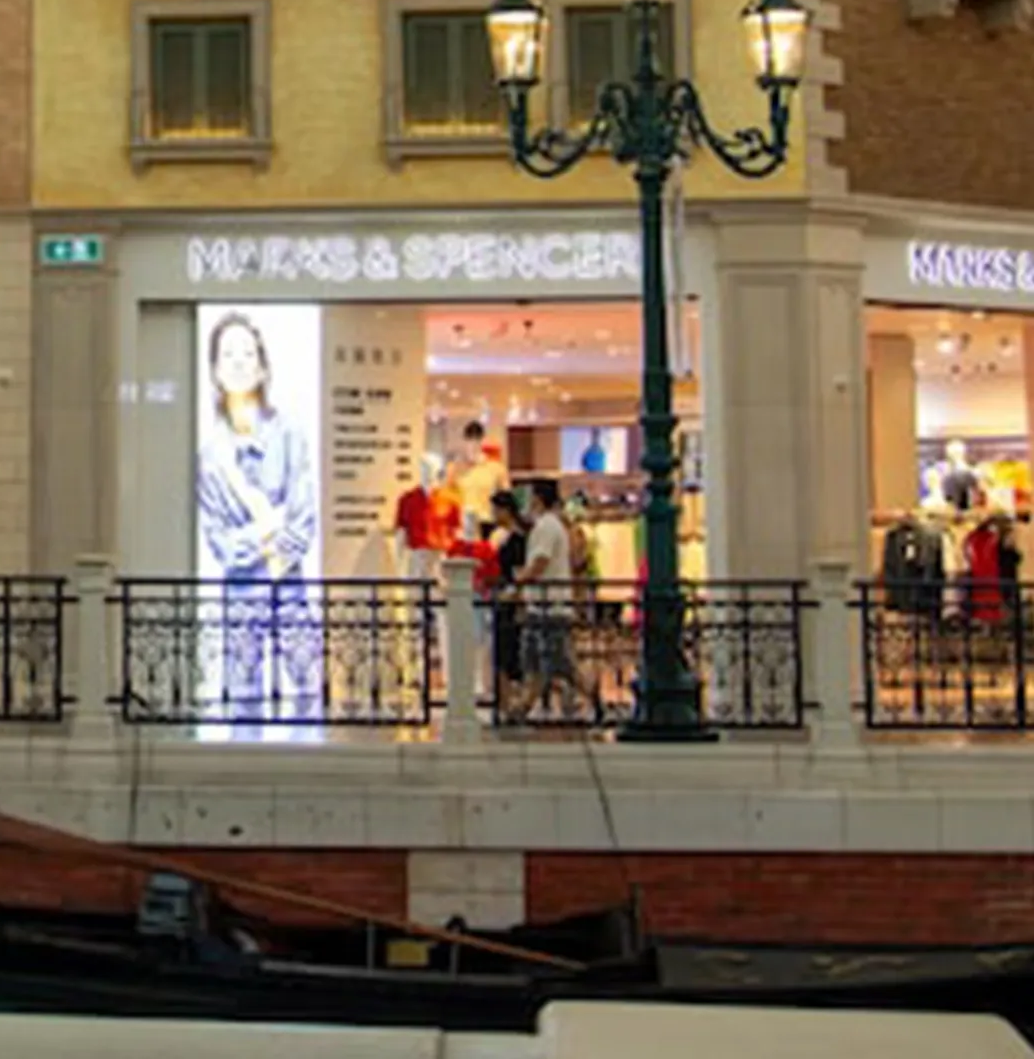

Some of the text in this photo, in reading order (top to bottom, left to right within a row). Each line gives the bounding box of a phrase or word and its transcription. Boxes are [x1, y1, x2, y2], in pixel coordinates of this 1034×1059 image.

[187, 233, 642, 282] MARKS & SPENCER
[908, 240, 1016, 291] MARKS
